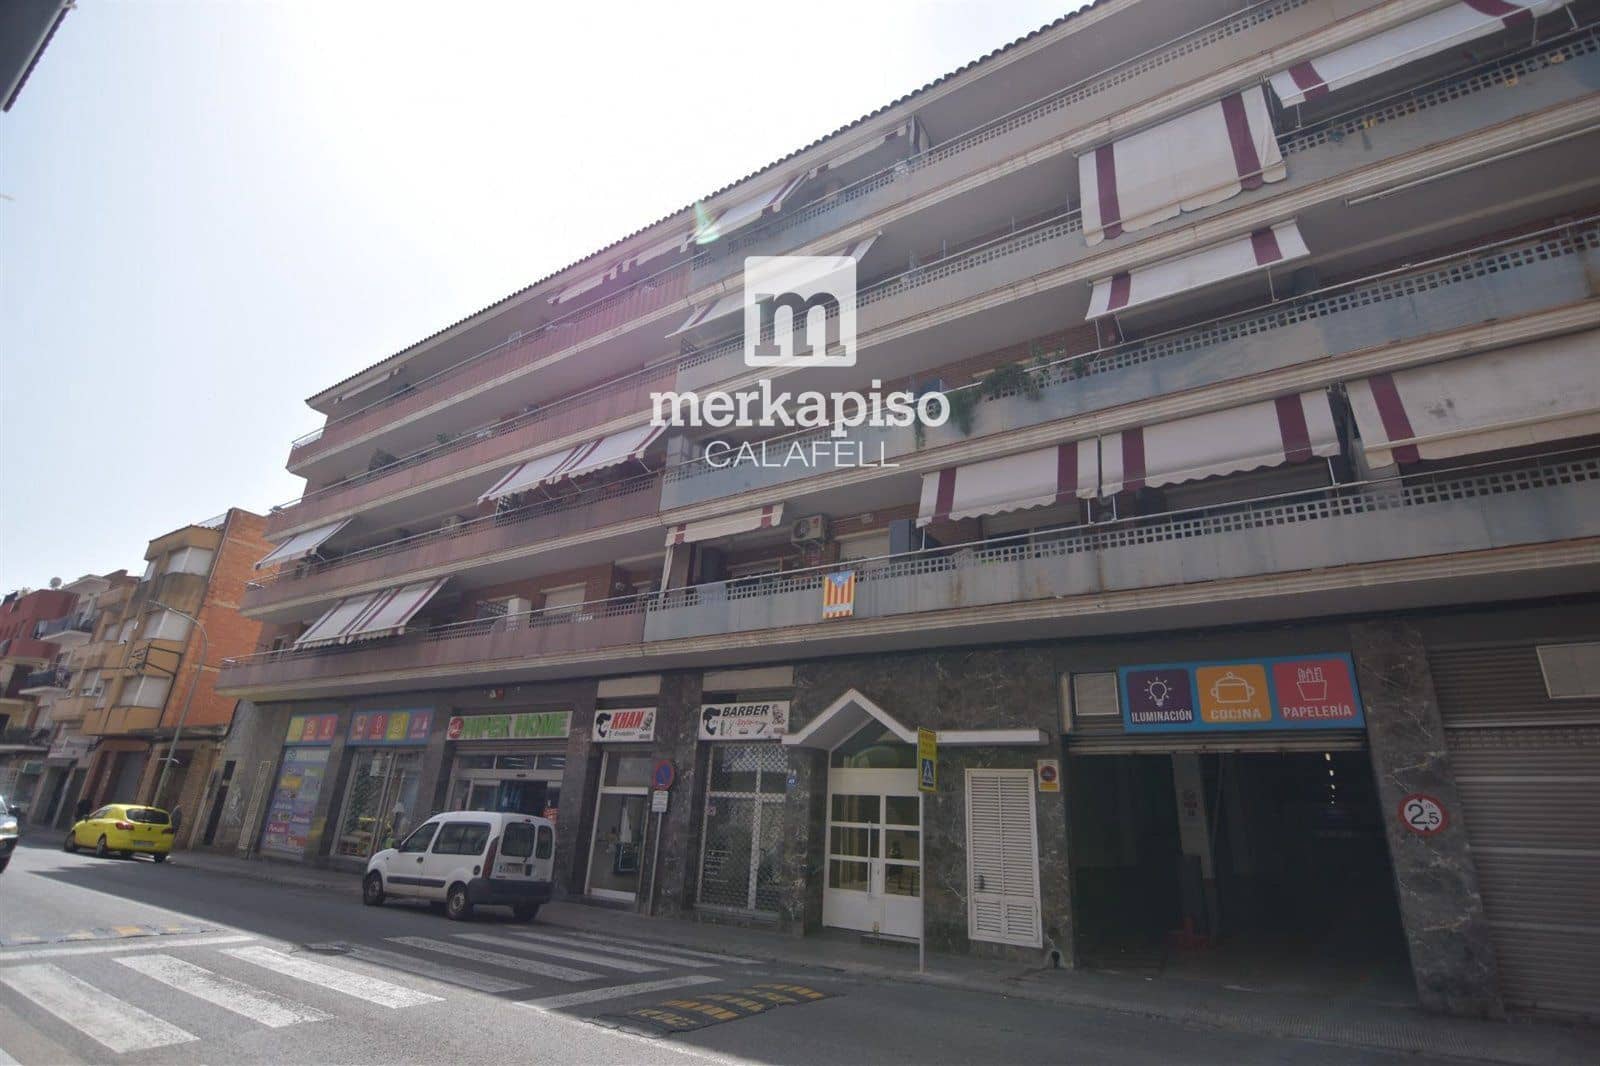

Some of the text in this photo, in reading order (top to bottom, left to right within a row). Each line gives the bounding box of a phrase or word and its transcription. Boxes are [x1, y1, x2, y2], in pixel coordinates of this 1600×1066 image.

[721, 704, 770, 717] BARBER
[1130, 707, 1193, 724] ILUMINACIÓN
[1209, 707, 1262, 721] COCINA
[1282, 703, 1353, 719] PAPELERÍA
[610, 710, 645, 729] KHAN
